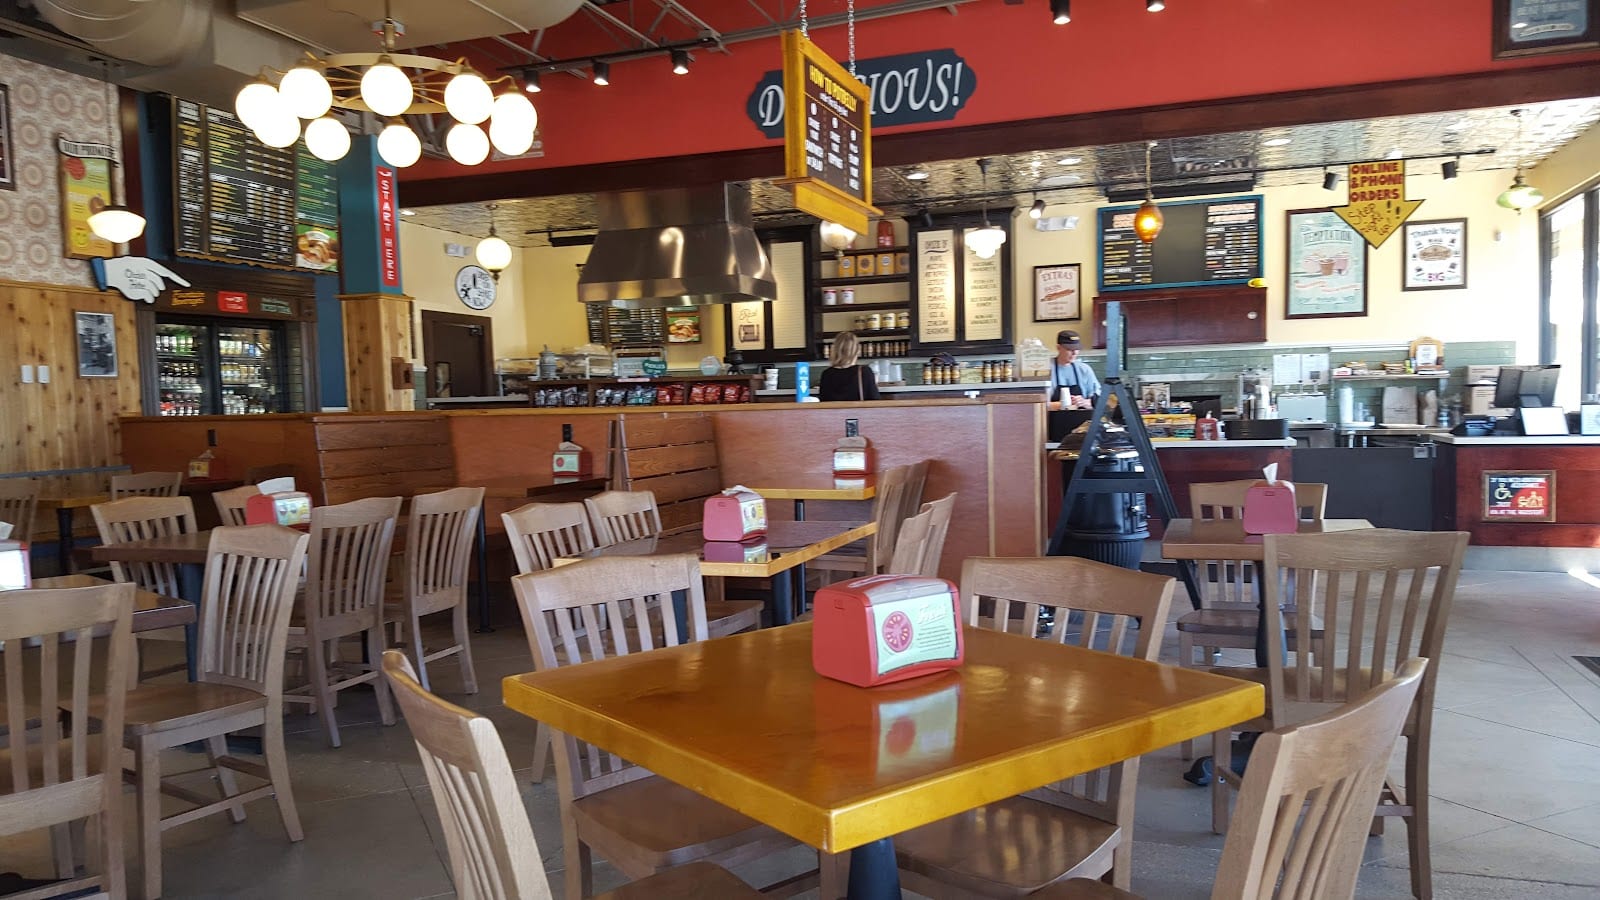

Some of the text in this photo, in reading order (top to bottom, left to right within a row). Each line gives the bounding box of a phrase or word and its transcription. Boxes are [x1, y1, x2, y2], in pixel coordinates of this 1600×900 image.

[1351, 162, 1399, 175] ONLINE
[1351, 188, 1400, 203] ORDERS
[380, 180, 395, 281] START HERE
